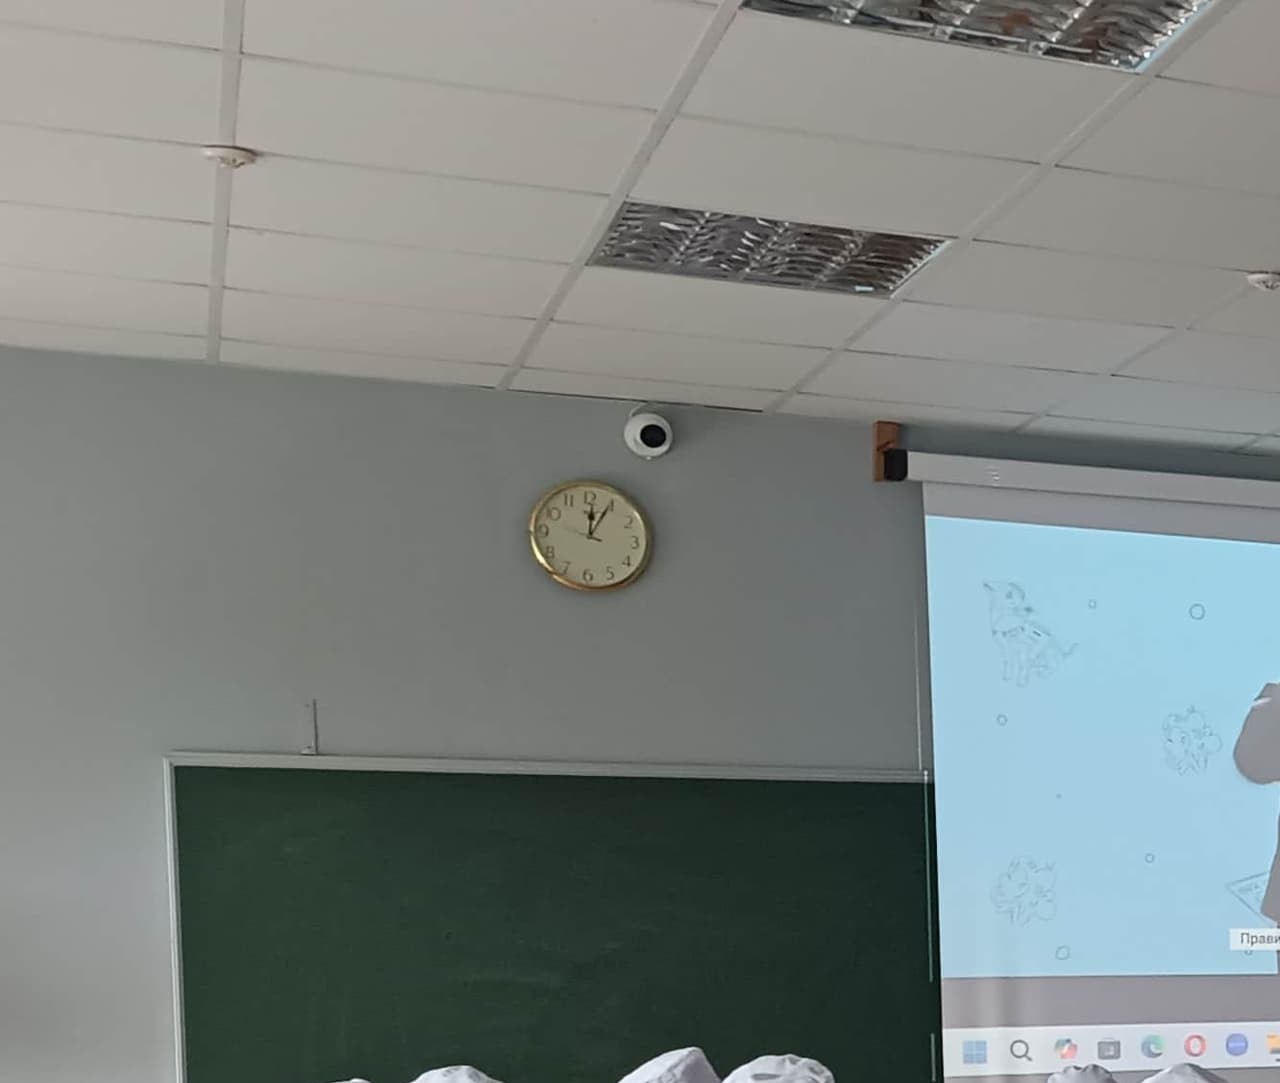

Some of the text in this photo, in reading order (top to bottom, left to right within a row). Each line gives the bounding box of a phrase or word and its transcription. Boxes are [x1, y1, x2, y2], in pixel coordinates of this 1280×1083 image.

[624, 516, 633, 529] 2
[539, 525, 549, 537] 9
[631, 535, 640, 549] 3
[545, 546, 555, 559] 8
[560, 561, 571, 575] 7
[622, 556, 631, 567] 4
[582, 569, 593, 582] 6
[606, 566, 615, 580] 5
